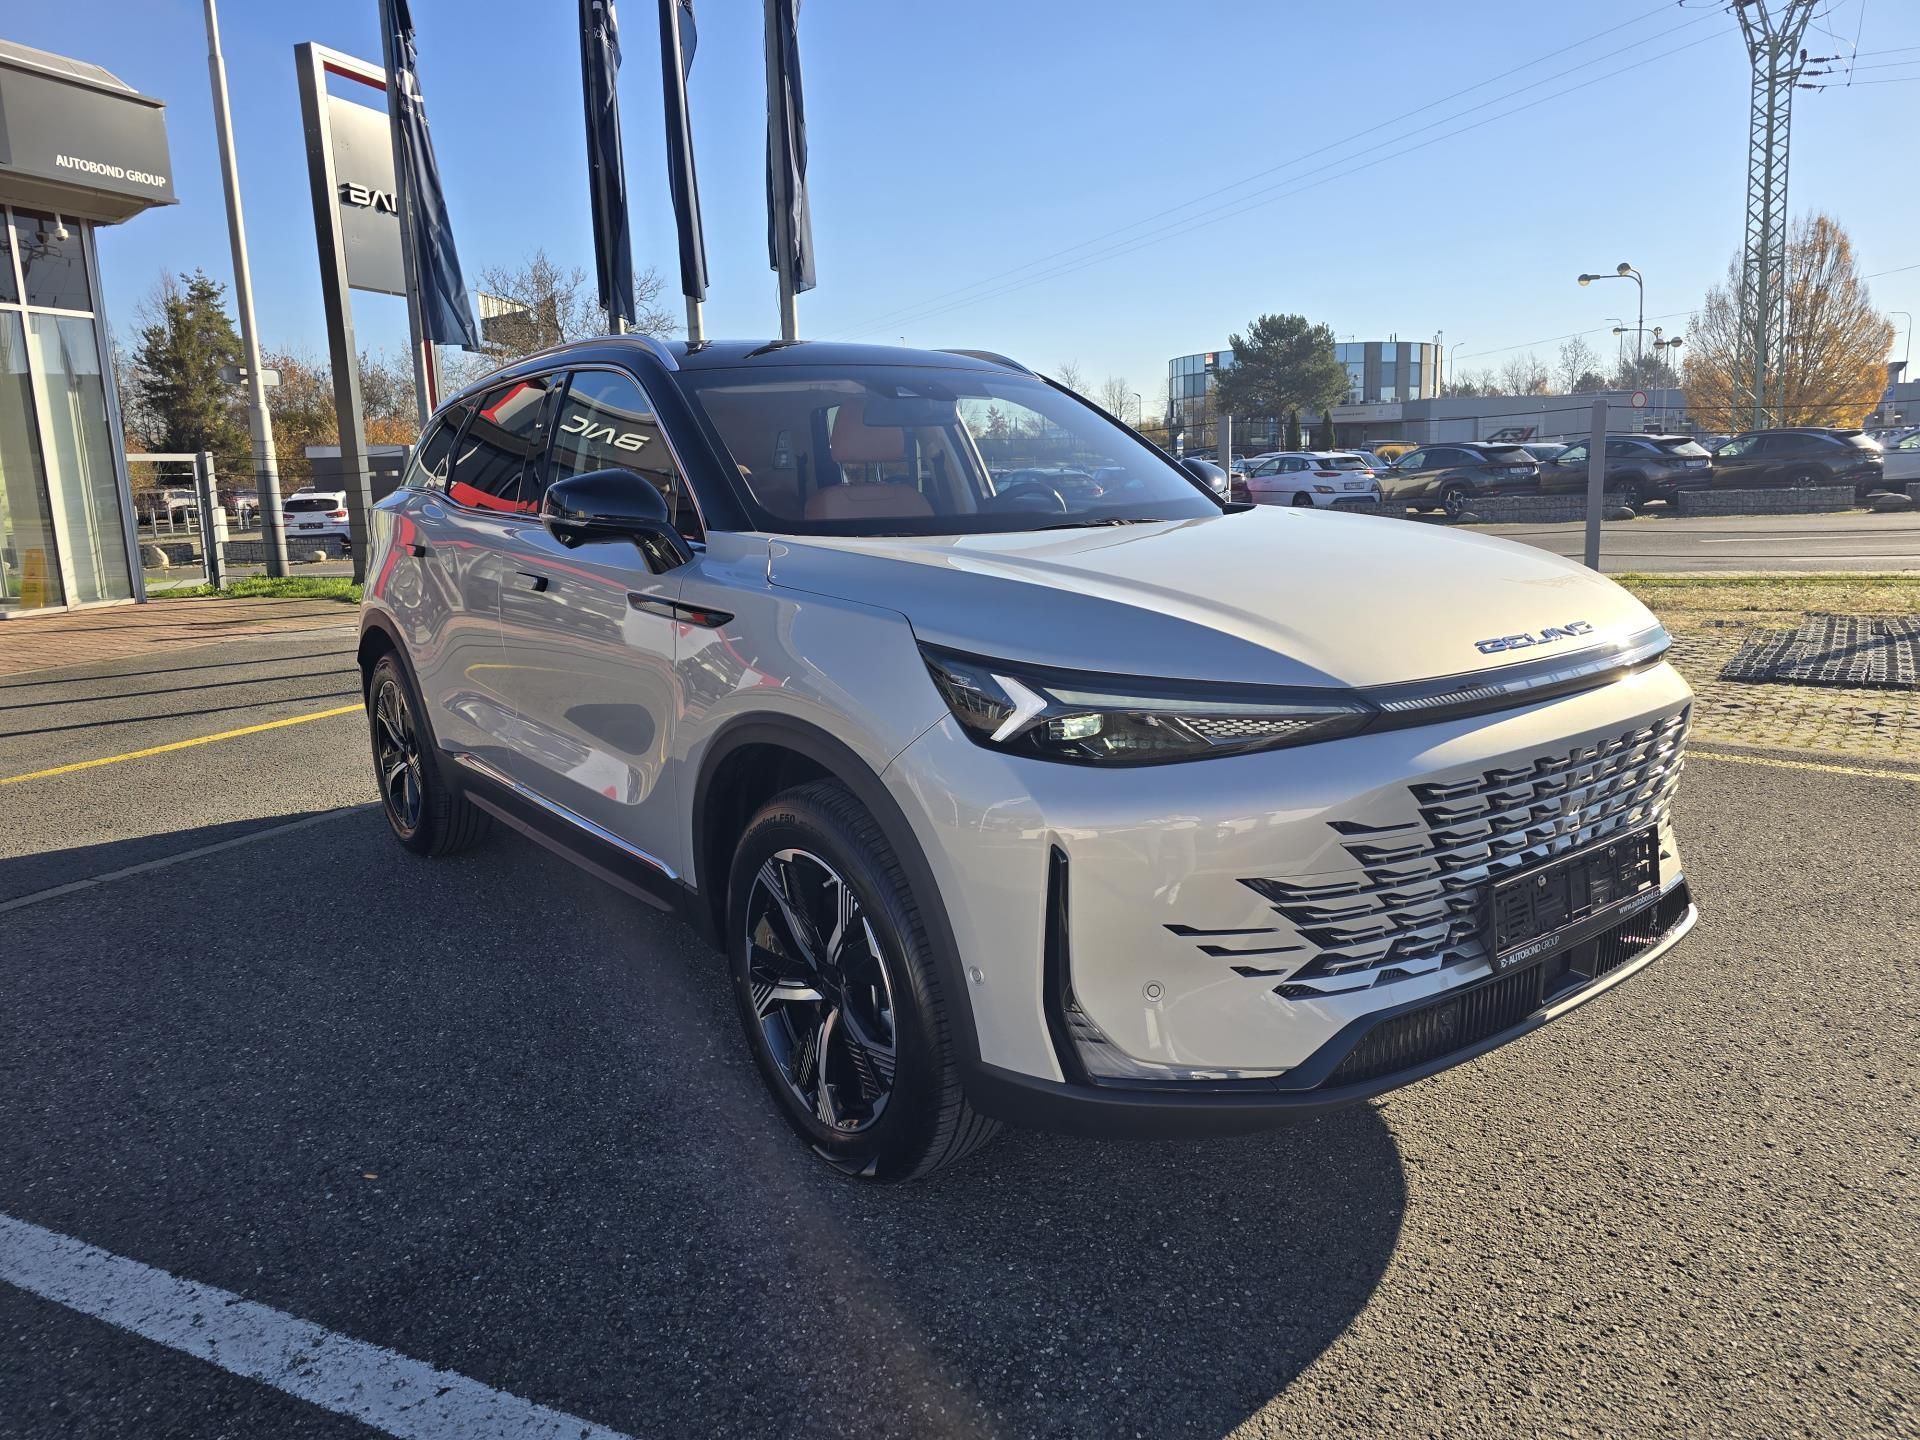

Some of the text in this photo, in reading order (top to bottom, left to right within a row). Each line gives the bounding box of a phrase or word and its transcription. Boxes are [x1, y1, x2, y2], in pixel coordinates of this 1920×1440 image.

[55, 154, 166, 187] AUTOBOND GROUP
[348, 182, 397, 212] BAI
[1474, 620, 1594, 654] BEIJING
[1618, 889, 1660, 914] www.autobond.cz
[1508, 935, 1560, 965] AUTOBOND GROUP
